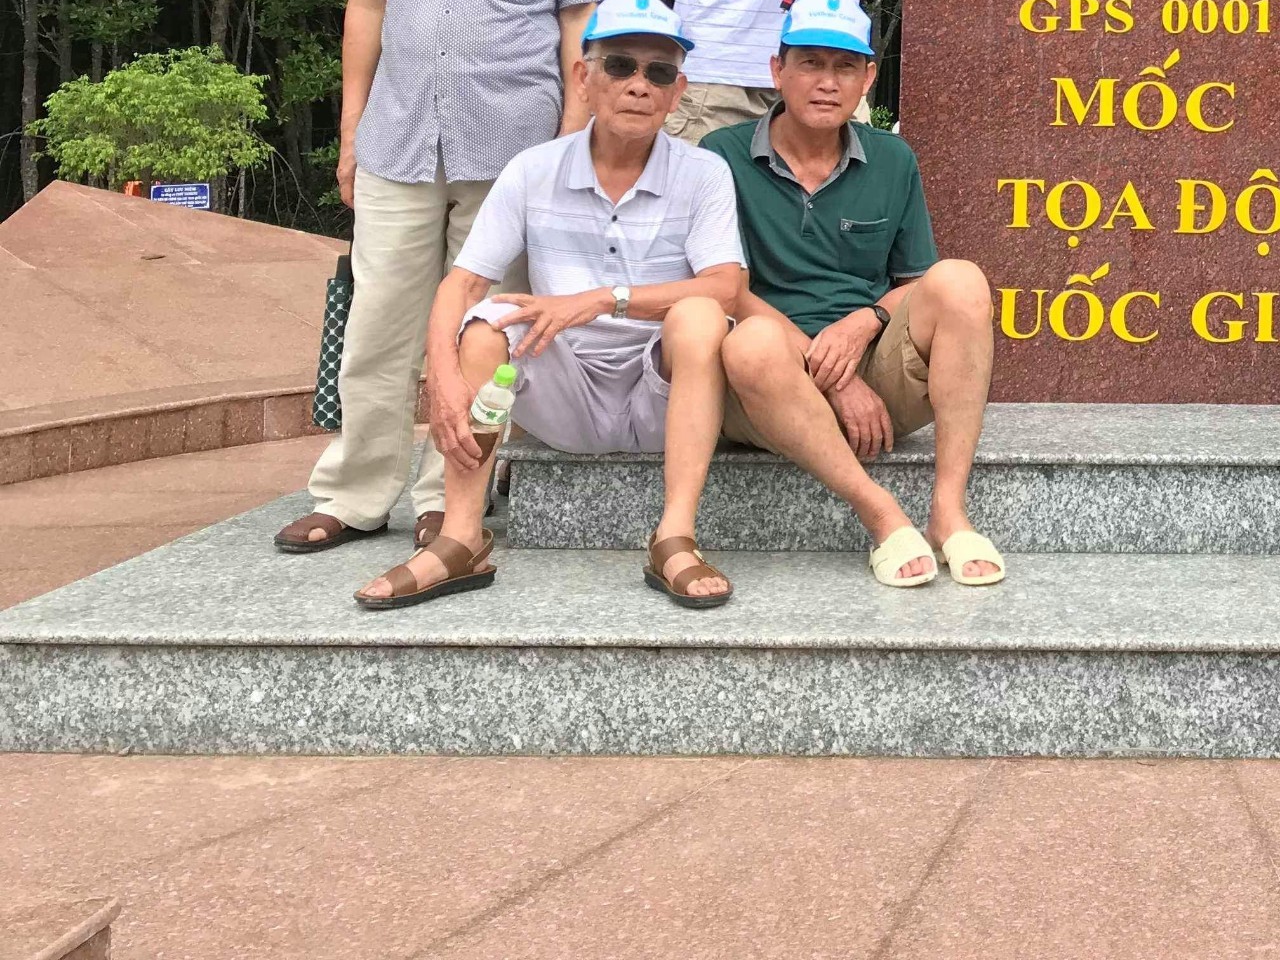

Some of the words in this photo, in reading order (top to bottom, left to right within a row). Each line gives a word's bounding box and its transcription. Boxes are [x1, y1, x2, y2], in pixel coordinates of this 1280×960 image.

[1049, 48, 1237, 133] MỐC
[997, 178, 1156, 249] TỌA
[991, 262, 1161, 343] UỐC
